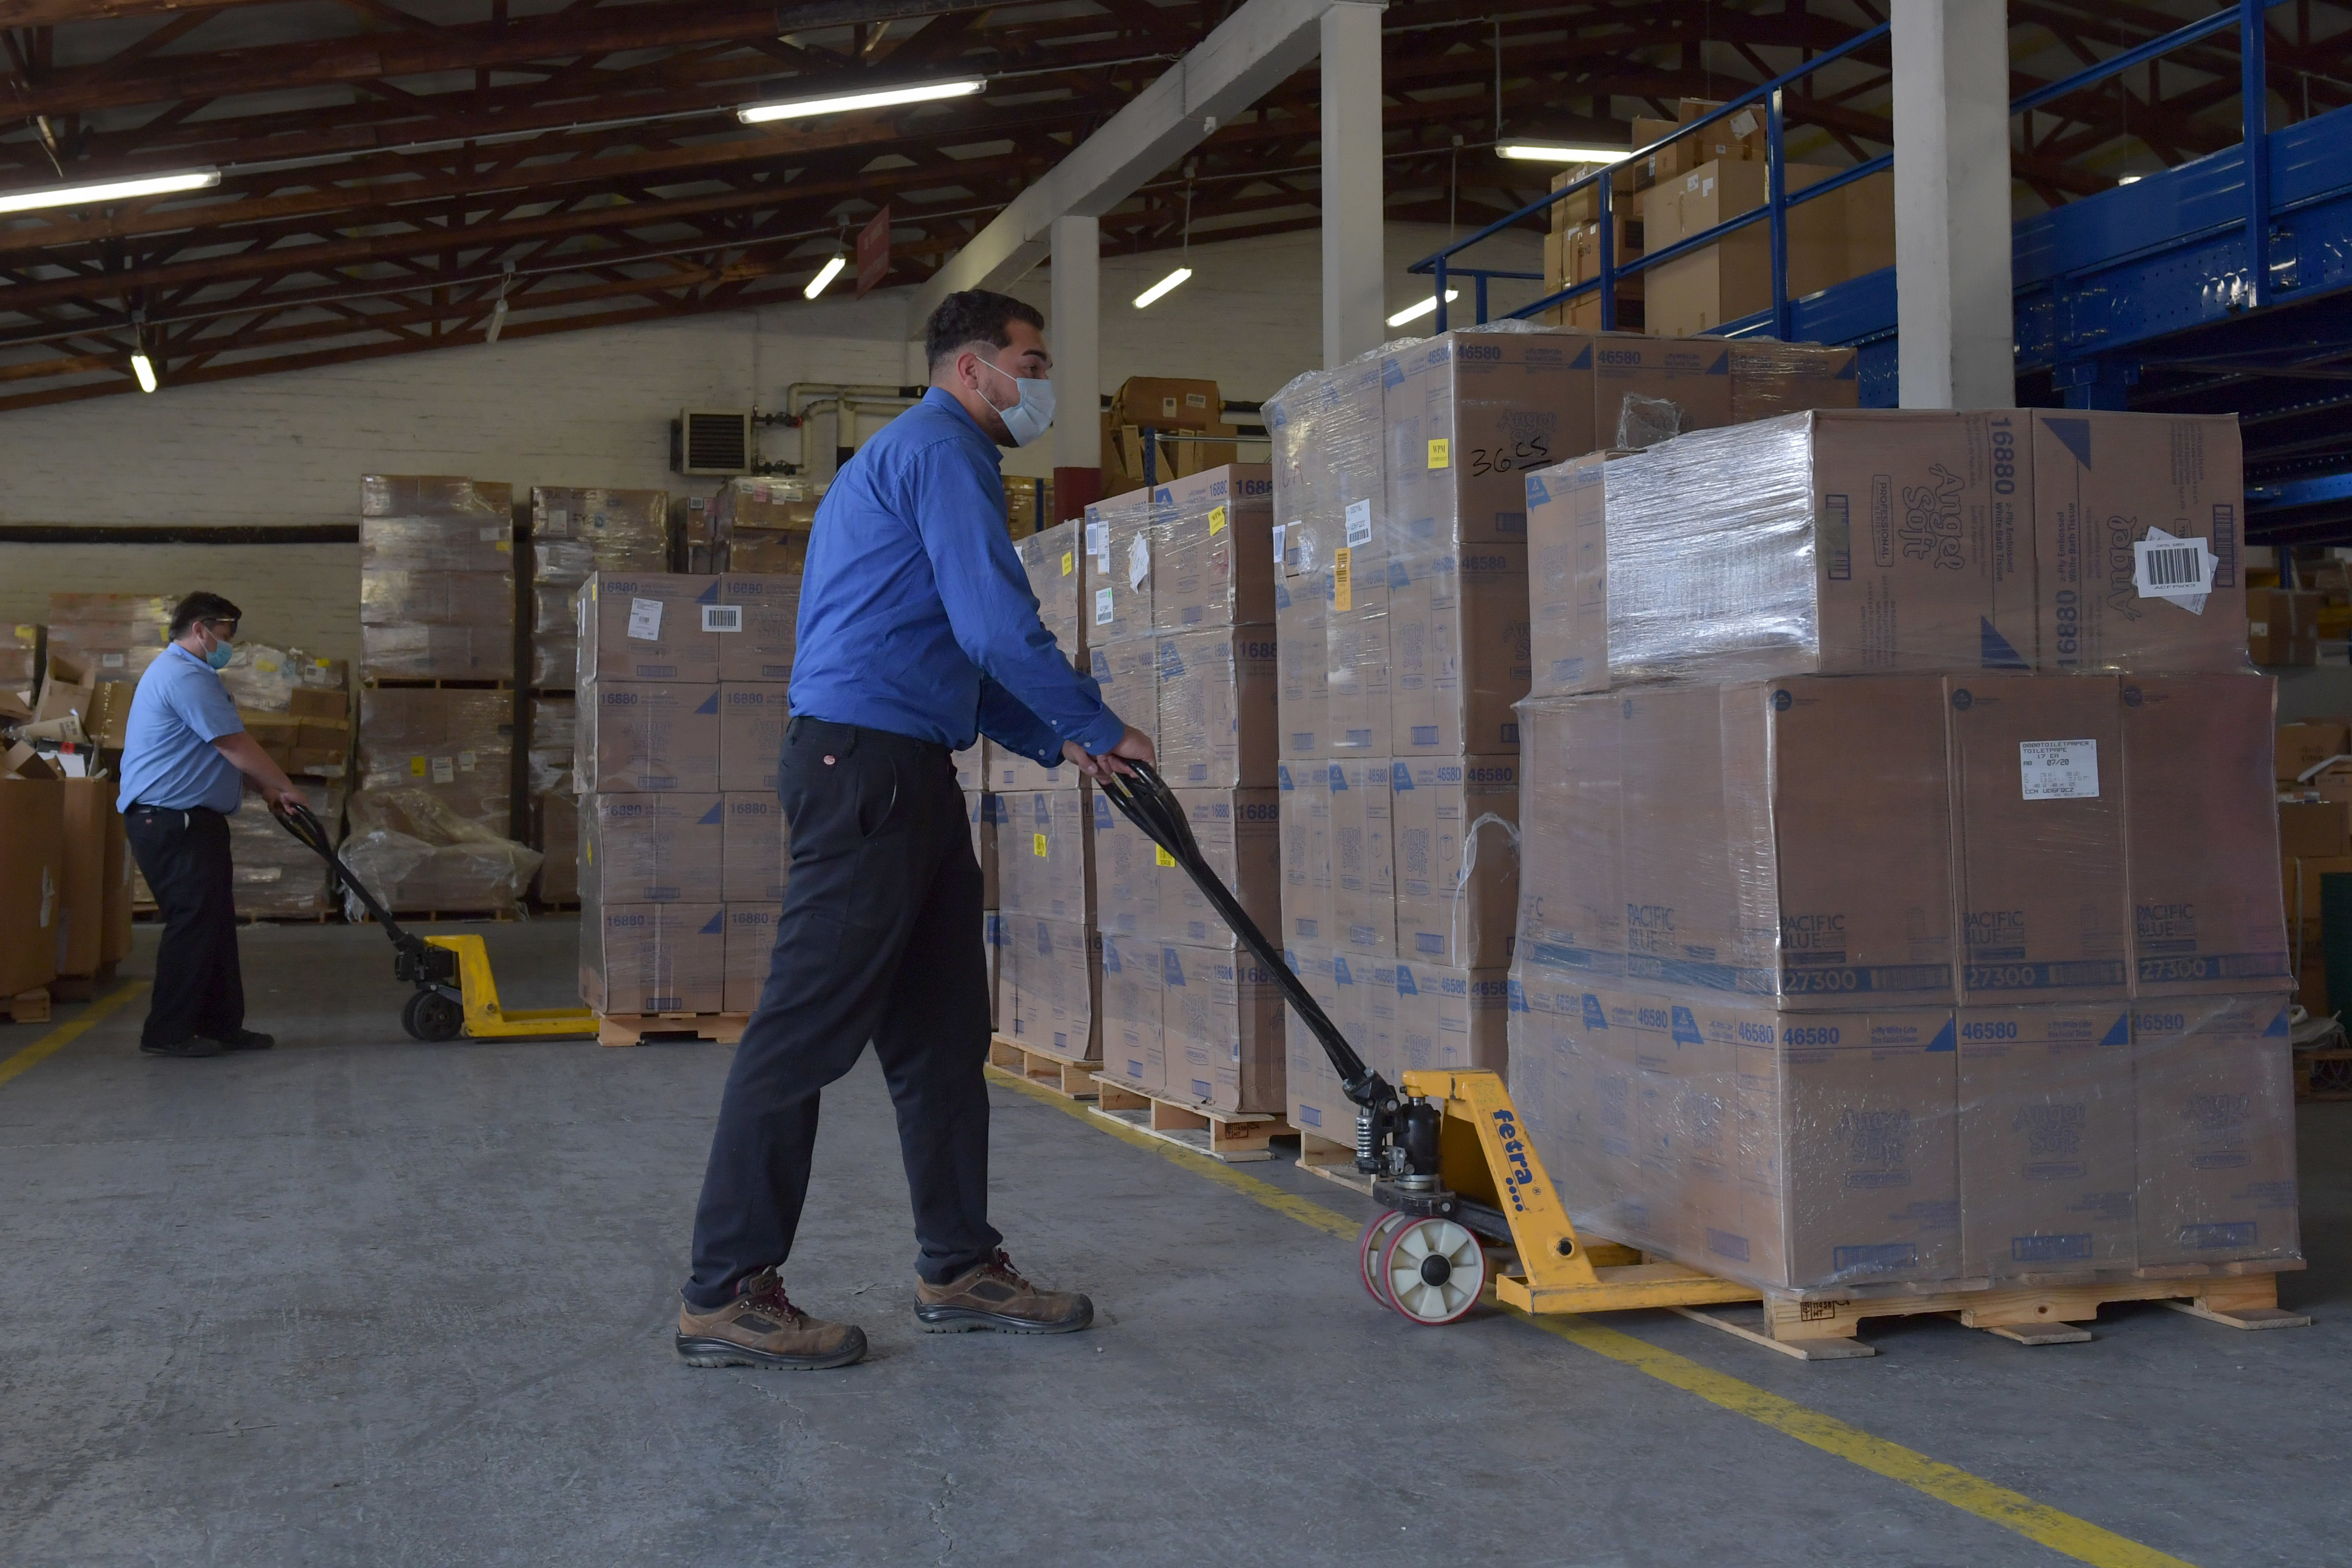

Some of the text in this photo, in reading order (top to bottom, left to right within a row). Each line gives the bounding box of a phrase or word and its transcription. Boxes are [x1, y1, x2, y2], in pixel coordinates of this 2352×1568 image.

[1456, 345, 1502, 360] 46580
[1597, 350, 1641, 365] 46580
[1433, 444, 1445, 454] WPM
[1991, 417, 2016, 495] 16880
[1210, 479, 1228, 498] 16880
[1879, 482, 1889, 559] PROFESSIONAL
[1898, 486, 1937, 560] Soft
[1928, 463, 1965, 570] Angel
[2005, 502, 2014, 573] 2-Ply Embossed
[2057, 511, 2065, 559] Embossed
[1461, 556, 1507, 570] 46580
[601, 581, 639, 593] 16880
[727, 582, 763, 594] 16880
[2056, 589, 2078, 668] 16880
[601, 693, 638, 705] 16880
[727, 693, 763, 704] 16880
[1368, 768, 1388, 783] 46580
[1437, 766, 1462, 782] 46580
[1467, 767, 1513, 782] 46580
[730, 803, 767, 814] 16880
[1212, 803, 1229, 818] 16880
[1239, 803, 1279, 820] 1688
[1400, 825, 1430, 852] Angel
[1407, 847, 1427, 877] Soft
[606, 915, 645, 927] 16880
[731, 913, 769, 924] 16880
[1626, 902, 1675, 931] PACIFIC
[1962, 911, 2024, 929] PACIFIC
[2136, 903, 2194, 921] PACIFIC
[1781, 915, 1845, 931] PACIFIC
[2137, 921, 2174, 938] BLUE
[1629, 927, 1658, 953] BLUE
[1782, 933, 1821, 949] BLUE
[1964, 928, 2004, 945] BLUE
[1374, 967, 1395, 984] 46580
[1970, 966, 2035, 988] 27300
[2141, 958, 2207, 980] 27300
[1441, 977, 1466, 995] 46580
[1471, 981, 1508, 996] 4658
[1786, 970, 1857, 991] 27300
[1637, 1007, 1668, 1029] 46580
[2134, 1013, 2185, 1031] 46580
[1739, 1021, 1774, 1044] 46580
[1782, 1027, 1840, 1046] 46580
[1962, 1021, 2018, 1040] 46580
[1492, 1109, 1533, 1185] fetra
